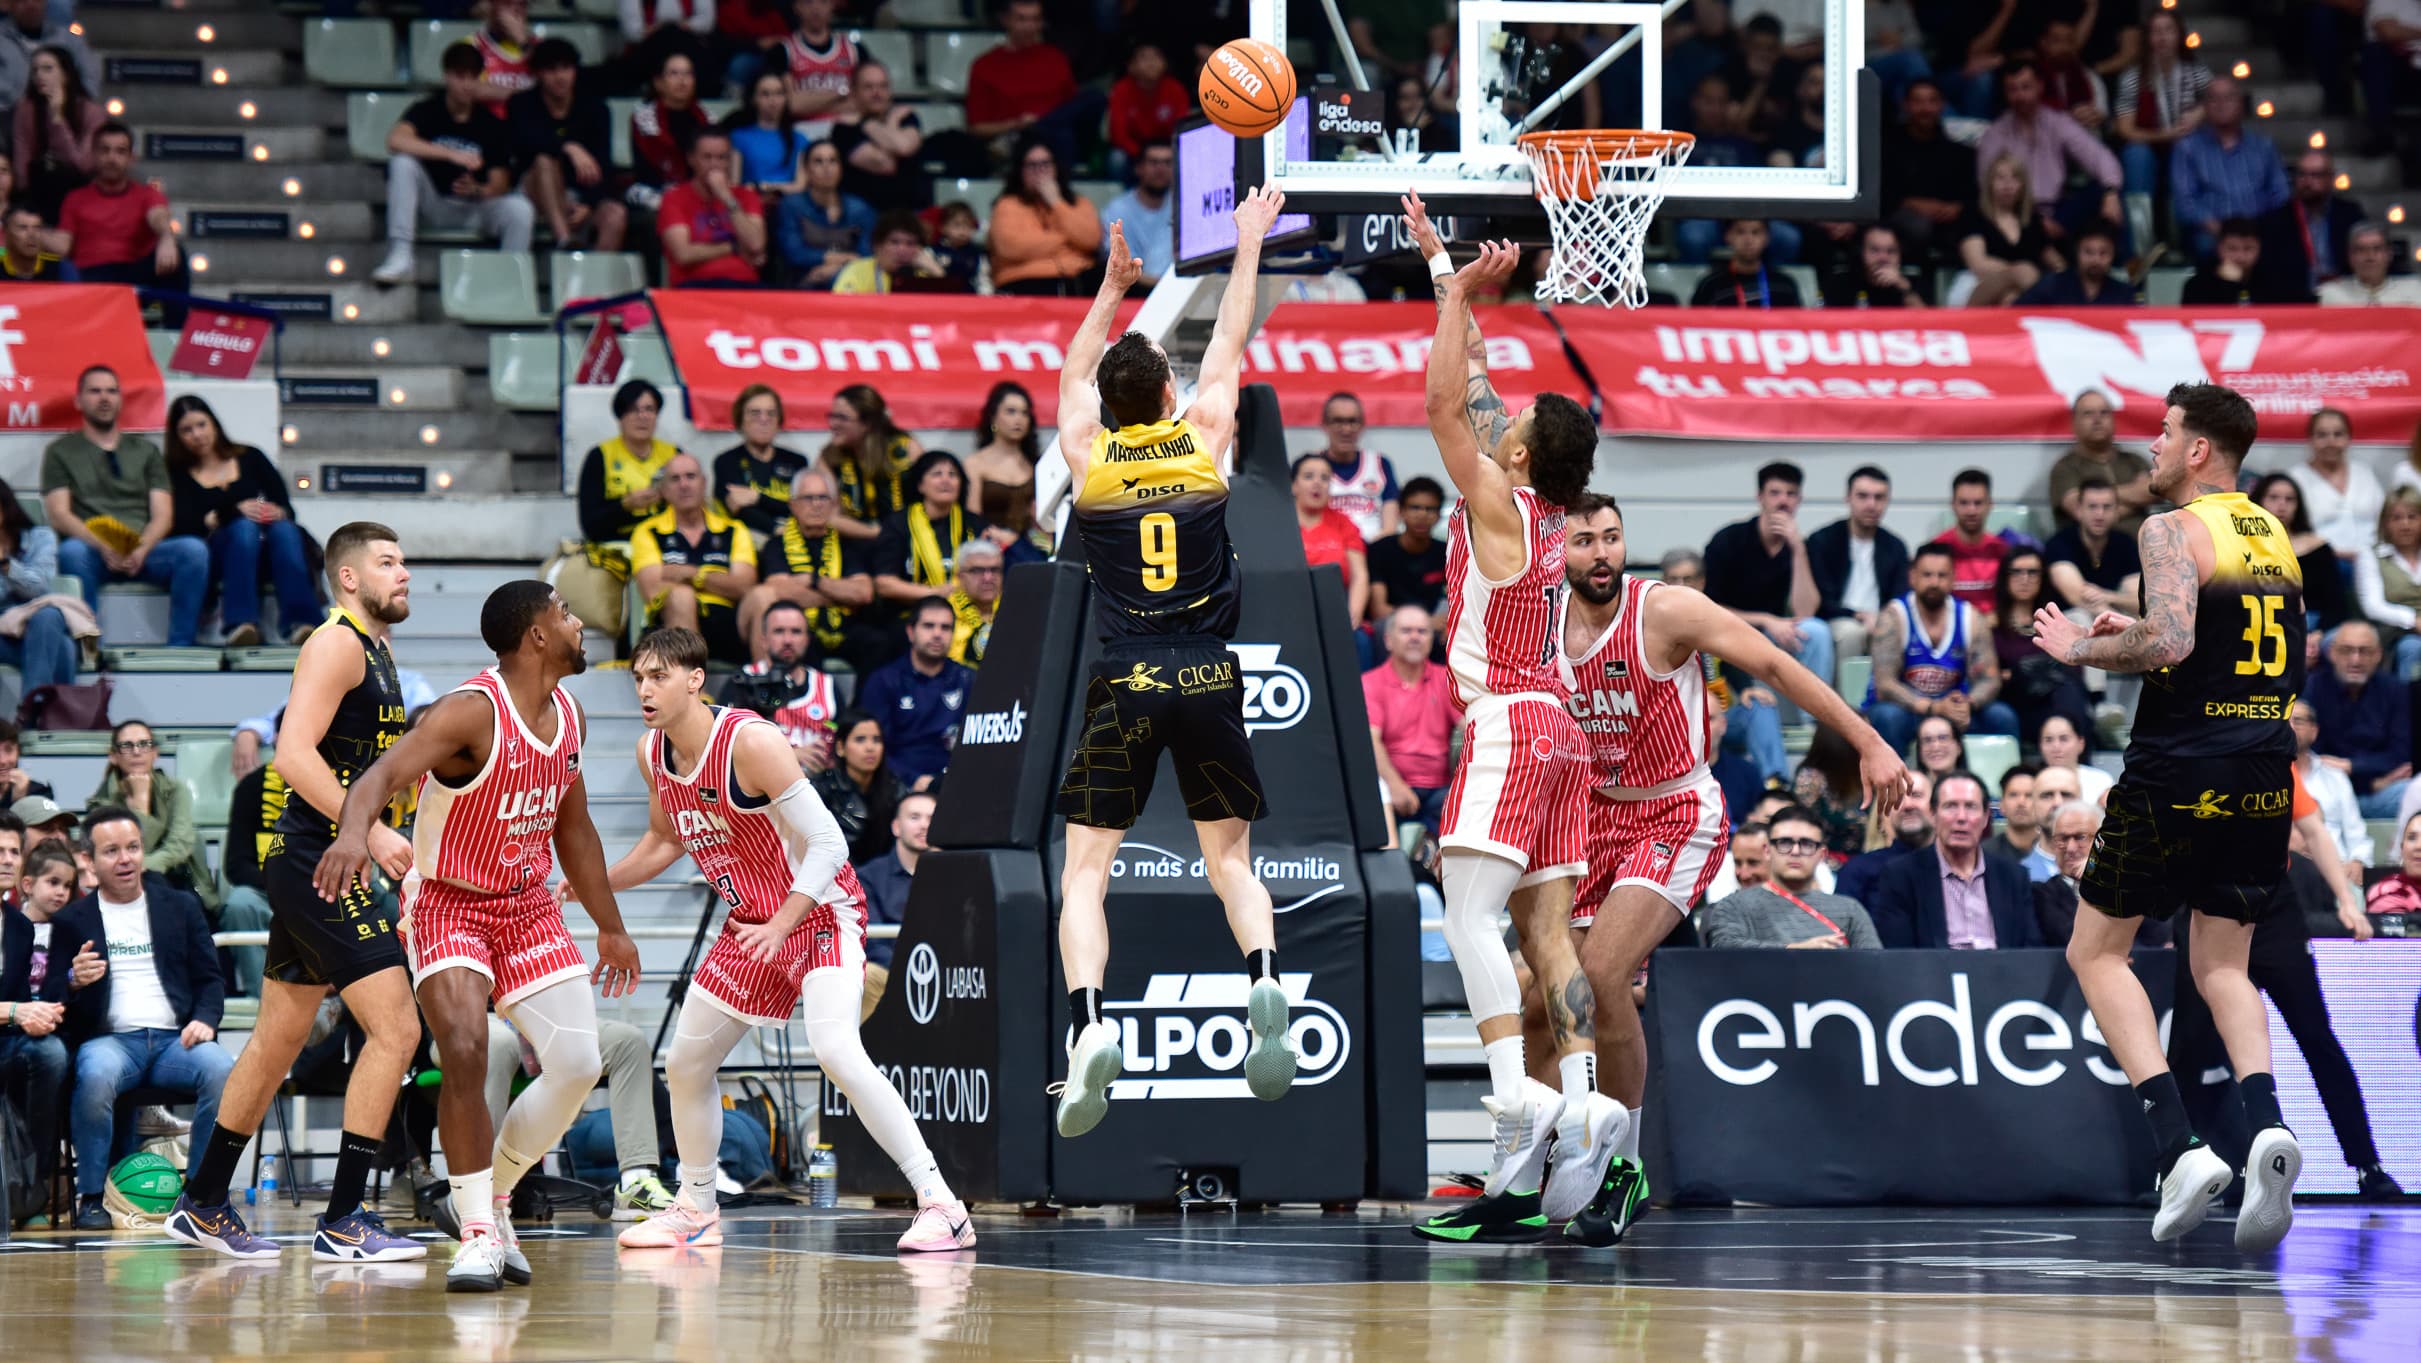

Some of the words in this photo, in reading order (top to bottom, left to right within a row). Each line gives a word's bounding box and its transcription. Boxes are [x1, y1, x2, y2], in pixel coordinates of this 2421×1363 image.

[1216, 48, 1263, 98] Wilson
[1319, 101, 1348, 119] liga
[1319, 118, 1382, 134] endesa
[705, 324, 942, 372] tomi
[1635, 365, 1729, 398] tu
[1742, 377, 1997, 401] marca
[1139, 512, 1178, 592] 9
[2235, 594, 2287, 677] 35
[1177, 661, 1234, 688] CICAR
[962, 699, 1028, 745] INVERSUS
[2205, 702, 2281, 719] EXPRESS
[2241, 788, 2289, 811] CICAR
[1134, 856, 1183, 878] más
[1254, 856, 1340, 881] familia
[711, 873, 741, 908] 3
[509, 935, 568, 967] INVERSUS
[707, 960, 751, 1000] INVERSUS
[945, 966, 987, 999] LABASA
[1101, 1014, 1339, 1072] LPOO
[1697, 973, 2174, 1087] endes
[909, 1065, 990, 1124] BEYOND
